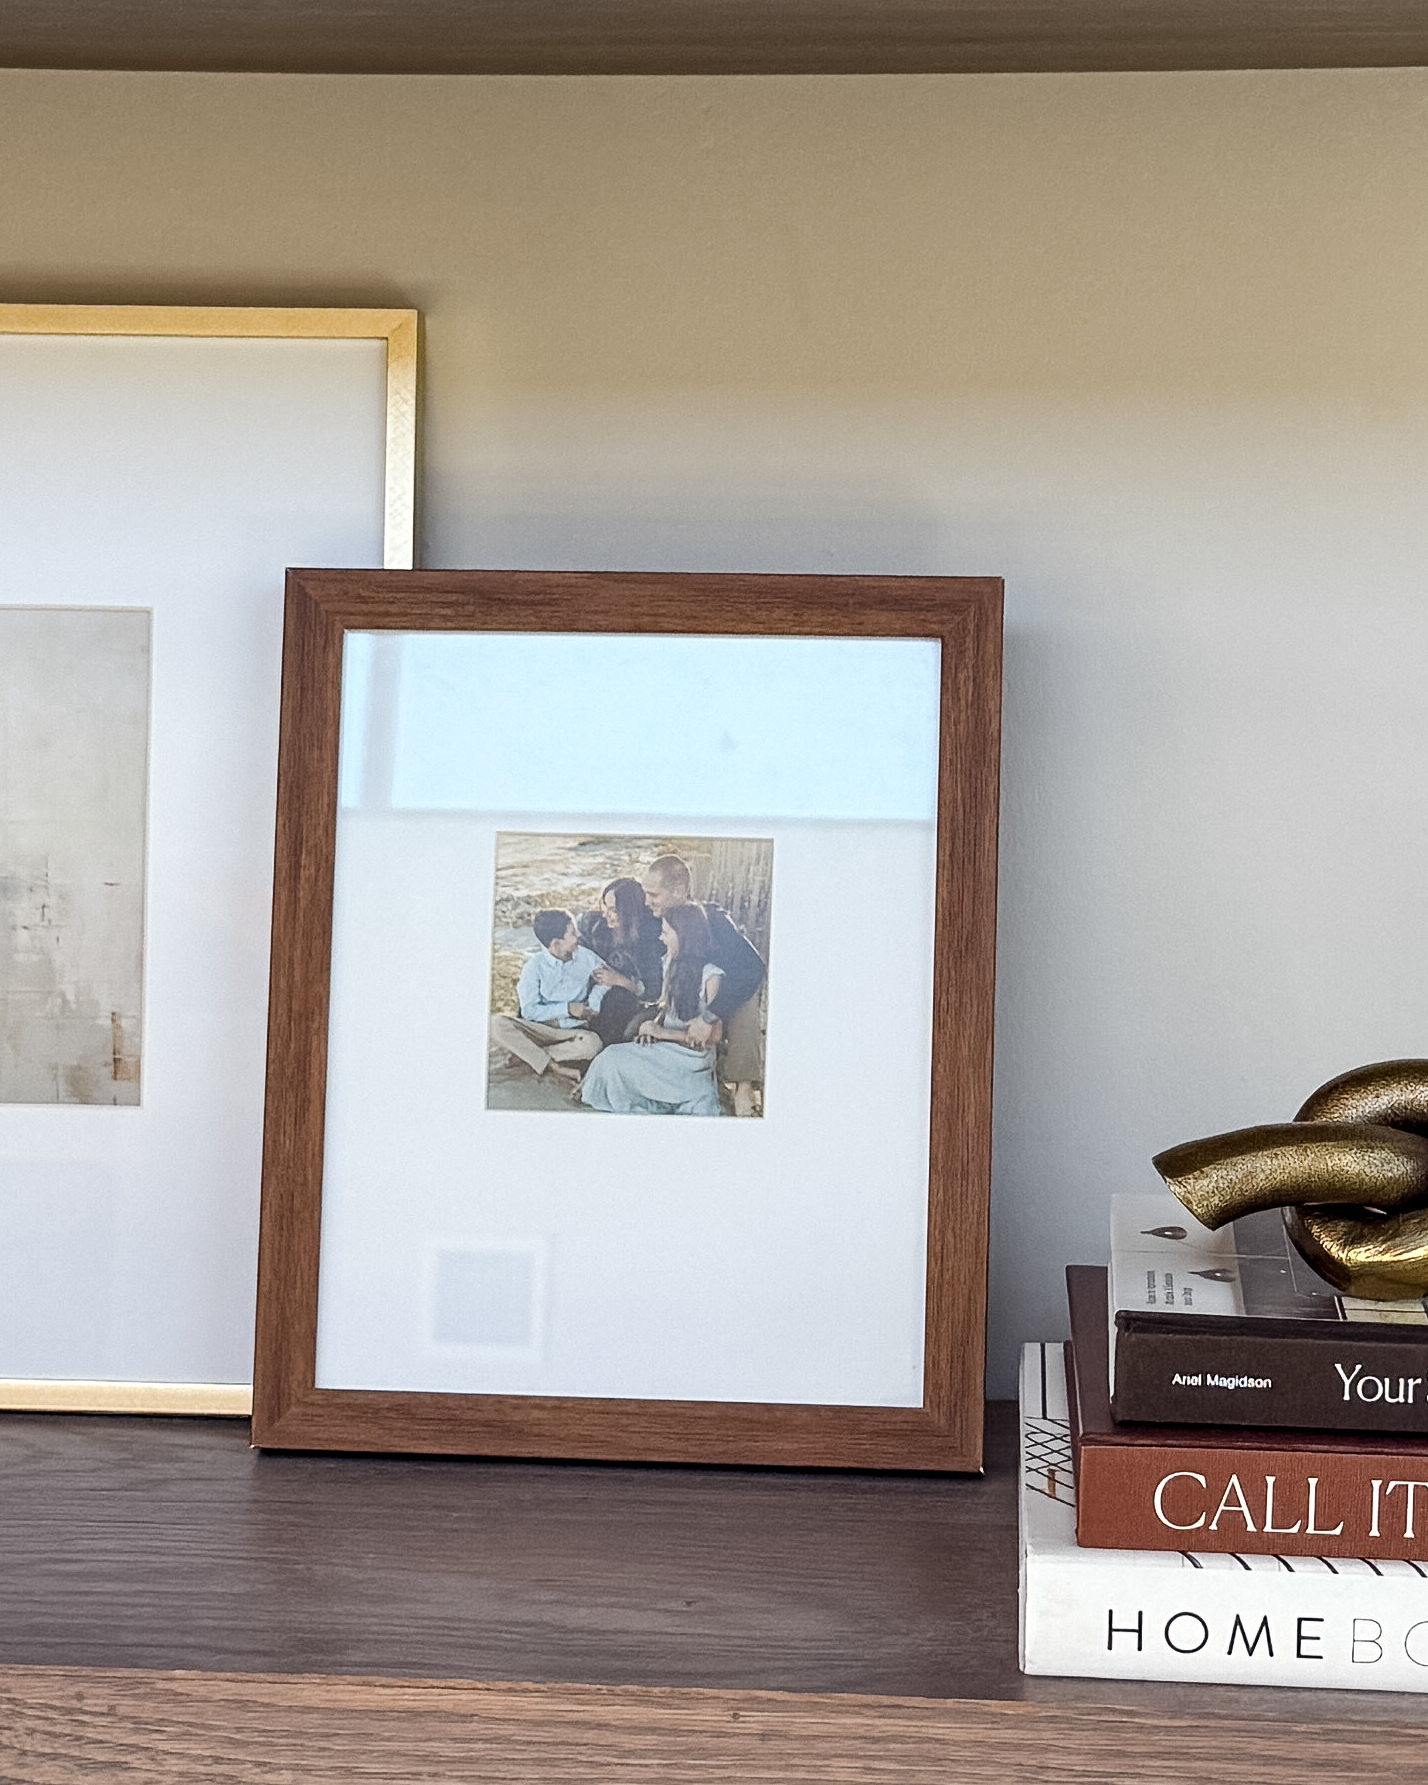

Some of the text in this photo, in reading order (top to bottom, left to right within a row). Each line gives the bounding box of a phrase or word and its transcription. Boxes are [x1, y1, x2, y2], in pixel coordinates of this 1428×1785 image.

[1172, 1373, 1272, 1390] Ariel Magidson
[1334, 1363, 1423, 1405] Your
[1153, 1471, 1344, 1536] CALL
